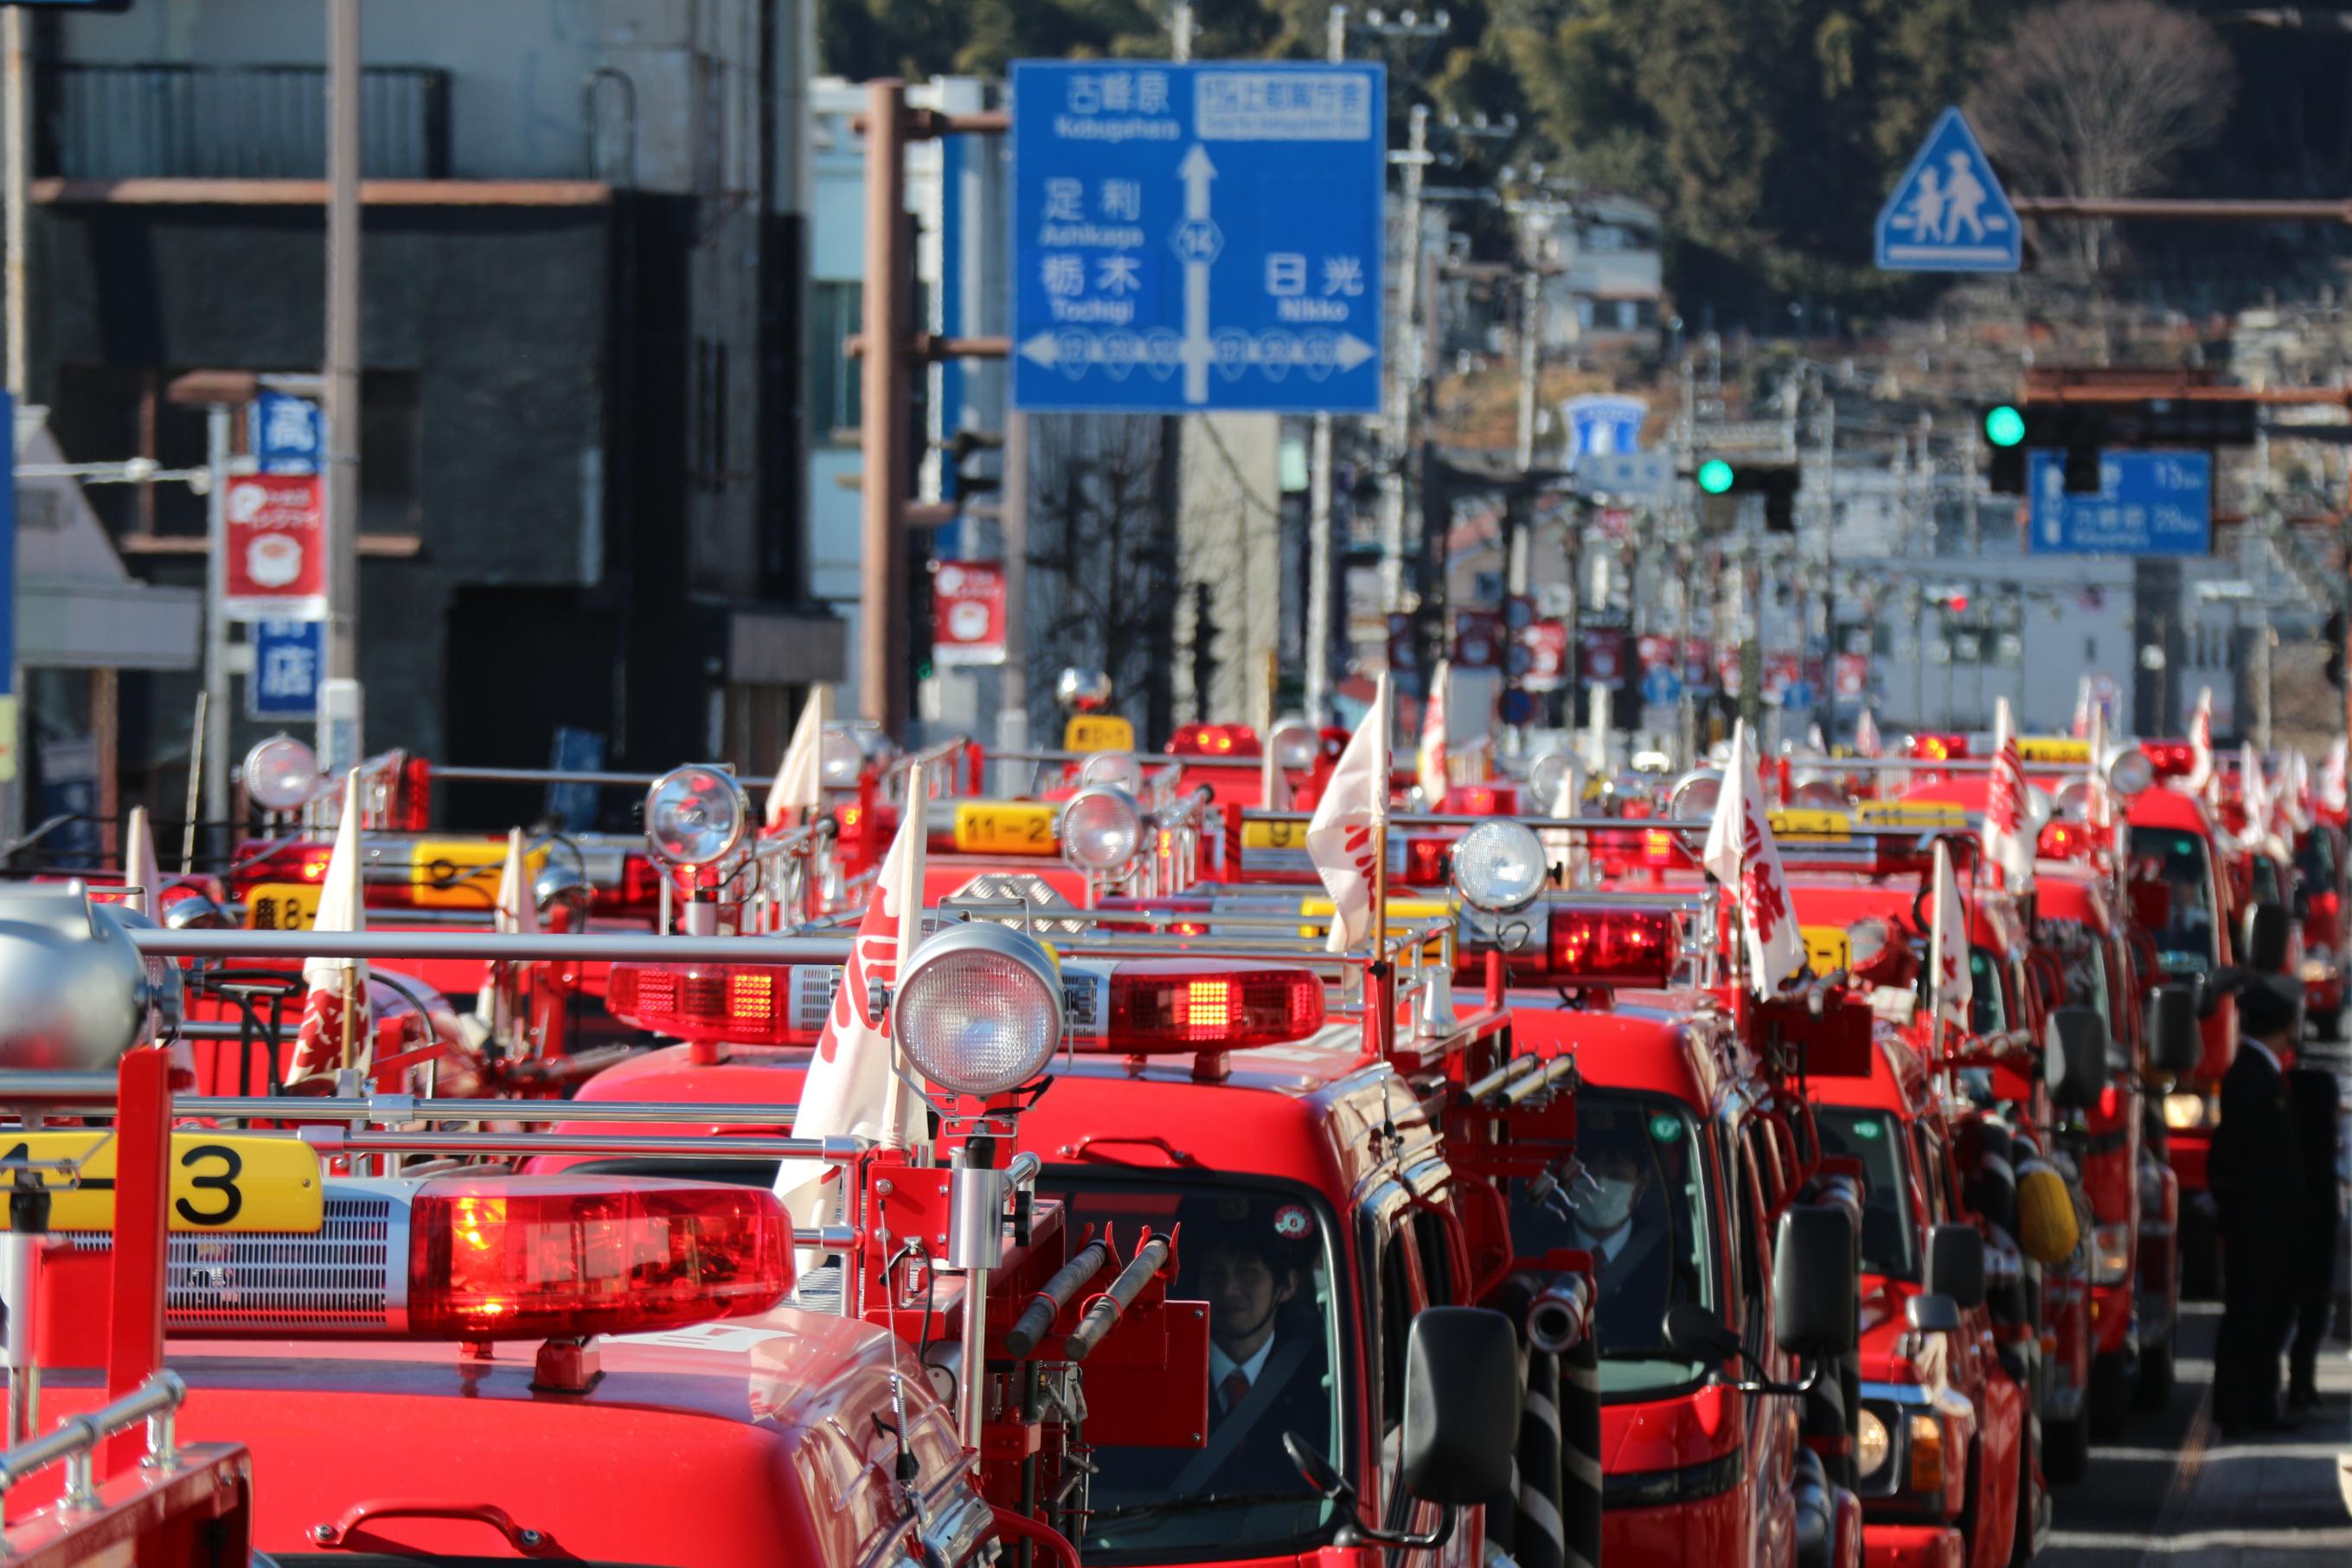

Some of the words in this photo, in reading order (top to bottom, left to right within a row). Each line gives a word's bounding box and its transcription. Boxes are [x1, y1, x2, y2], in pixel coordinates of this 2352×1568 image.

[1067, 73, 1170, 115] 古峰原
[1041, 176, 1142, 221] 足利
[1040, 222, 1144, 251] Ashikaga
[1041, 253, 1142, 297] 栃木
[1265, 253, 1364, 296] 日光
[1051, 297, 1135, 325] Tochigi
[1278, 297, 1349, 321] Nikko
[967, 816, 1047, 844] 11-2
